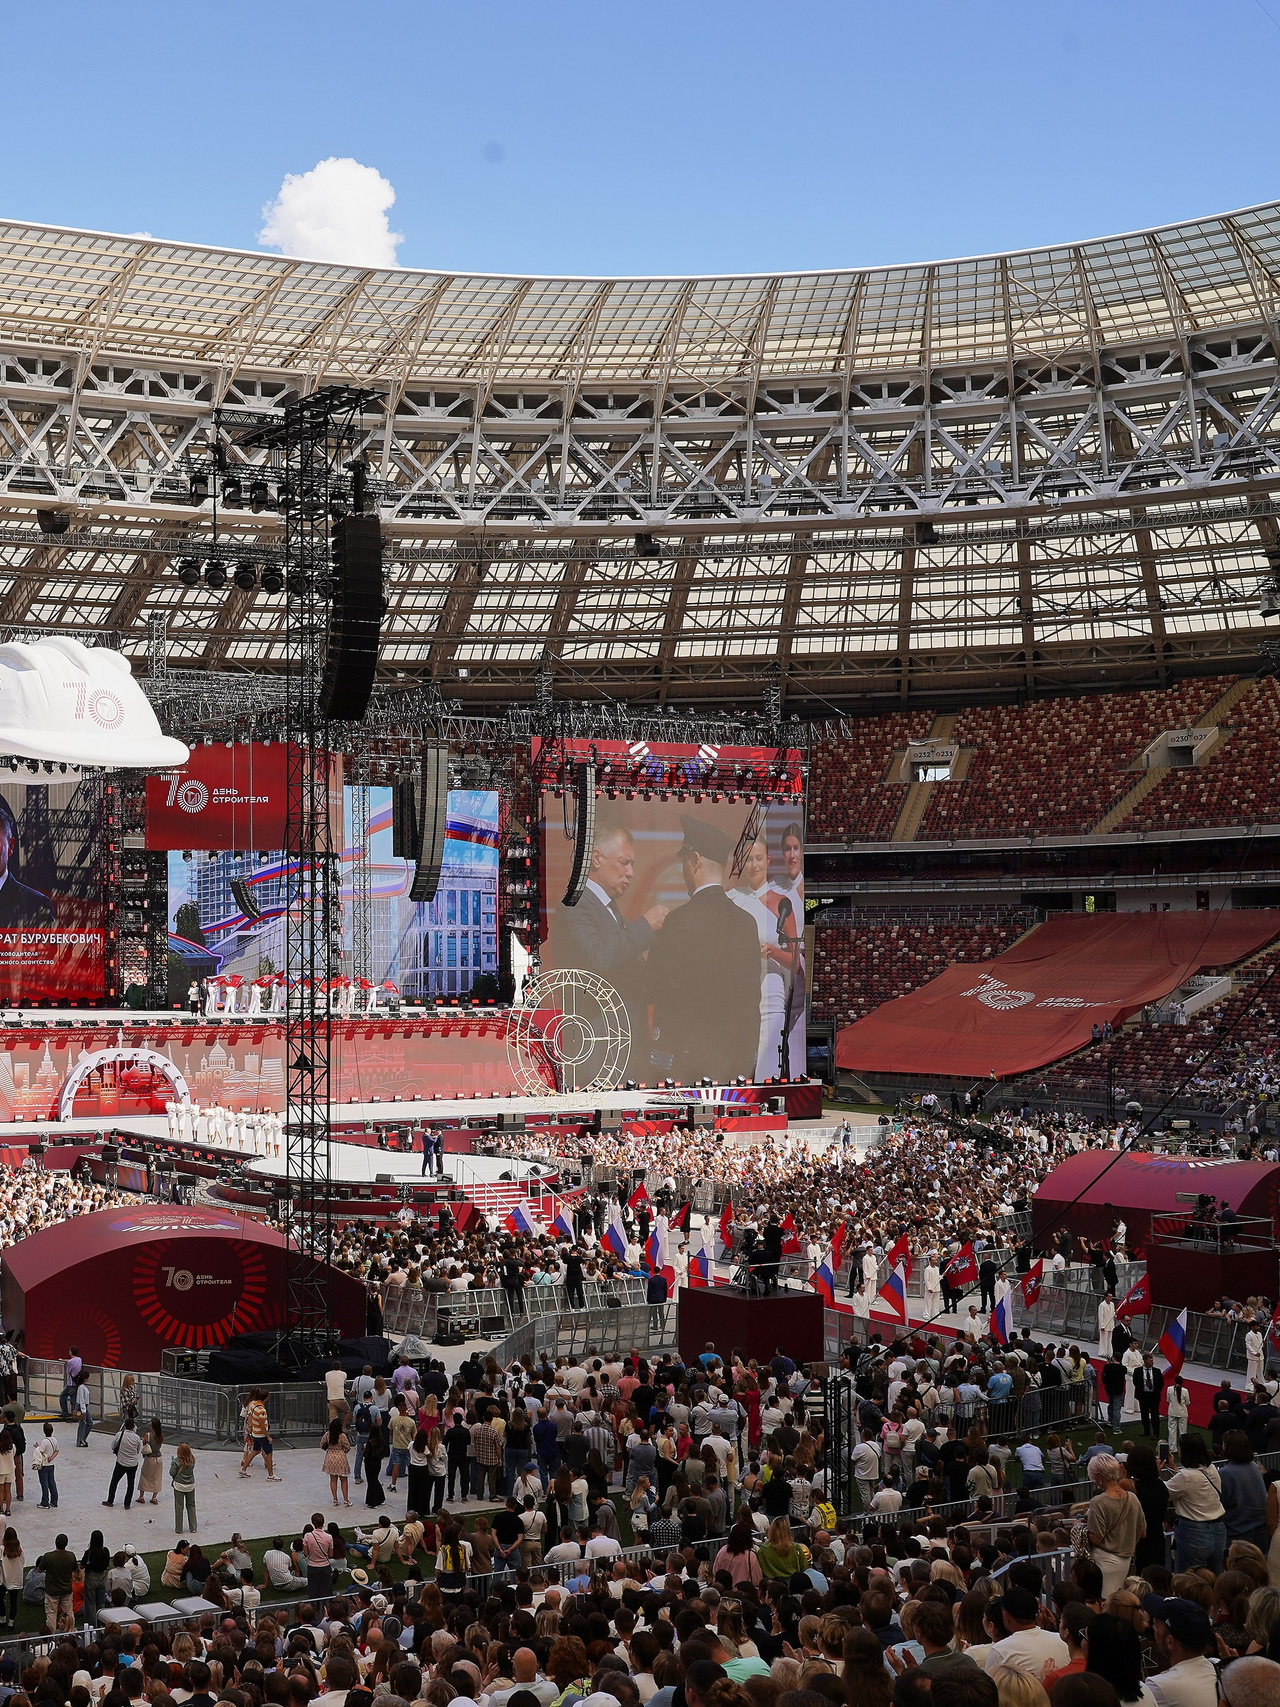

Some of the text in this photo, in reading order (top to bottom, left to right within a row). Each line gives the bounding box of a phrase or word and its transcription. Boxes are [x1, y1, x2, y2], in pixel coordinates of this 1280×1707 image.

[62, 682, 125, 730] 70
[160, 775, 209, 813] 70
[212, 796, 269, 804] СТРОИТЕЛЯ
[21, 933, 100, 944] БУРУБЕКОВИЧ
[161, 1266, 194, 1291] 70
